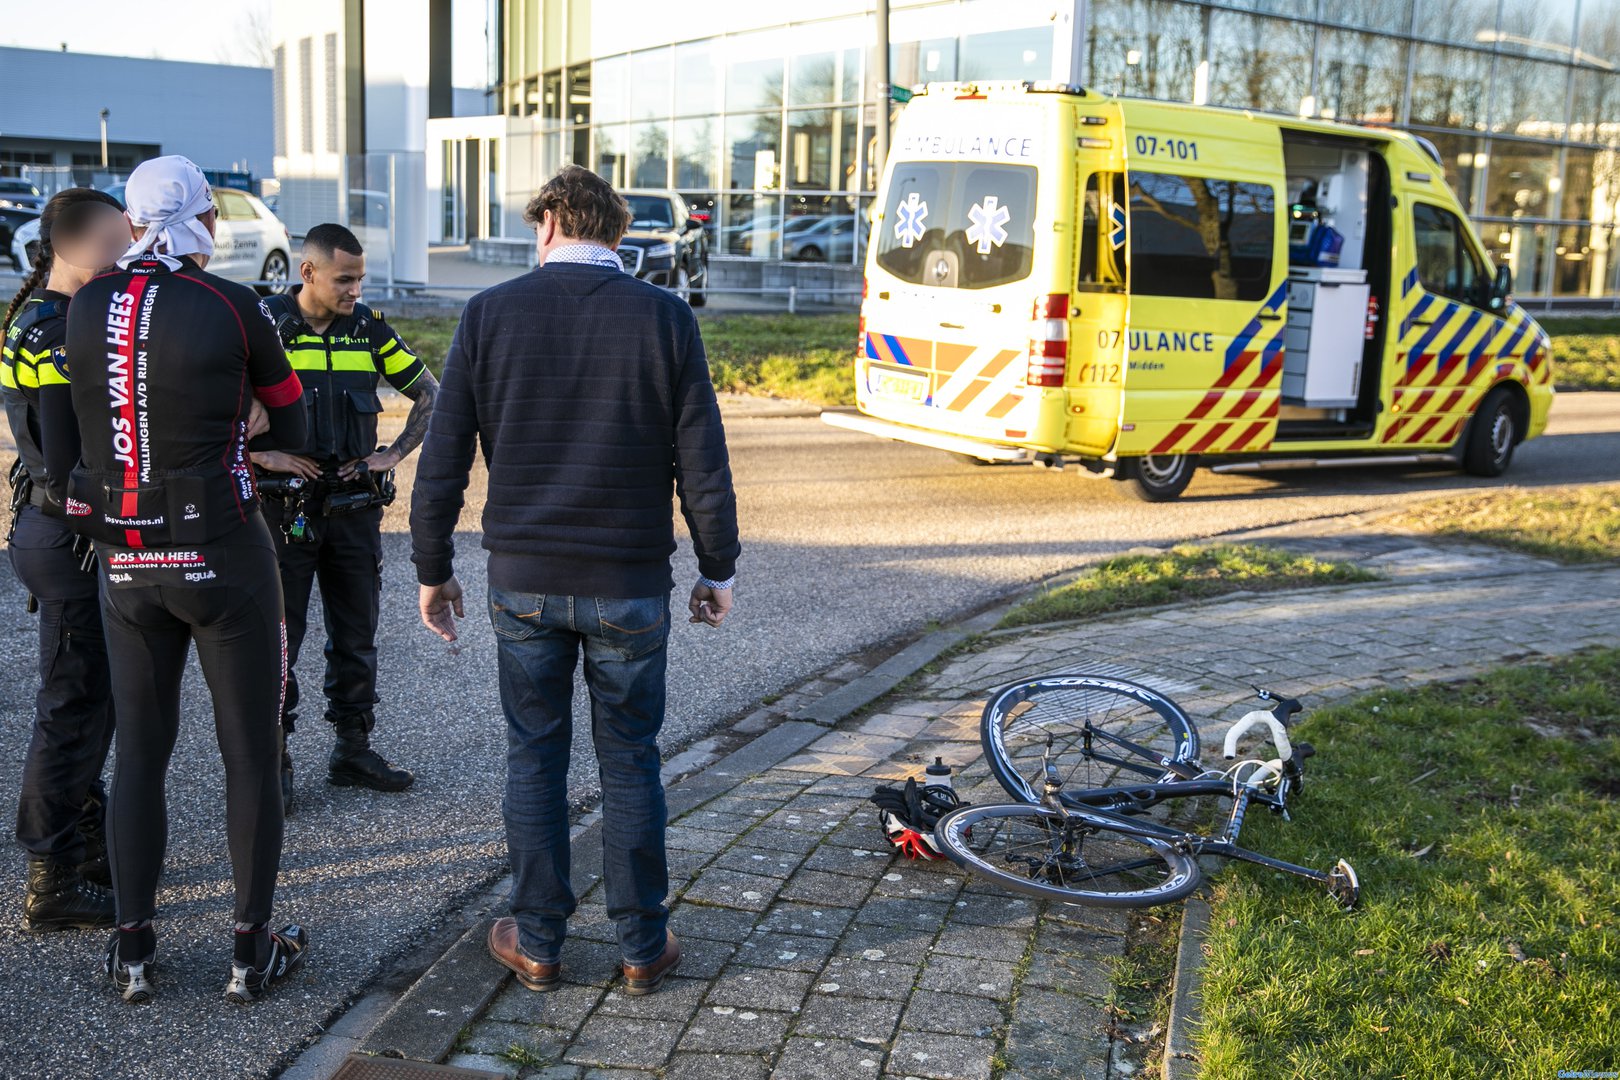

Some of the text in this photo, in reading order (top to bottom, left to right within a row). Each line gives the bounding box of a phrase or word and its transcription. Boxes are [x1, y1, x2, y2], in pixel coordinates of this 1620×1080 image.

[1135, 135, 1198, 161] 07-101
[139, 285, 160, 340] NIJMEGEN
[1098, 330, 1120, 349] 07
[138, 351, 148, 379] RIJN
[1090, 364, 1119, 383] 112
[1129, 362, 1165, 370] Midden
[107, 291, 135, 468] JOS VAN HEES
[138, 382, 147, 408] A/D
[138, 411, 150, 483] MILLINGEN
[104, 514, 164, 527] josvanhees.nl
[113, 551, 198, 563] JOS VAN HEES
[109, 573, 125, 584] agu
[185, 571, 206, 582] agu
[1040, 679, 1158, 702] COSMIC
